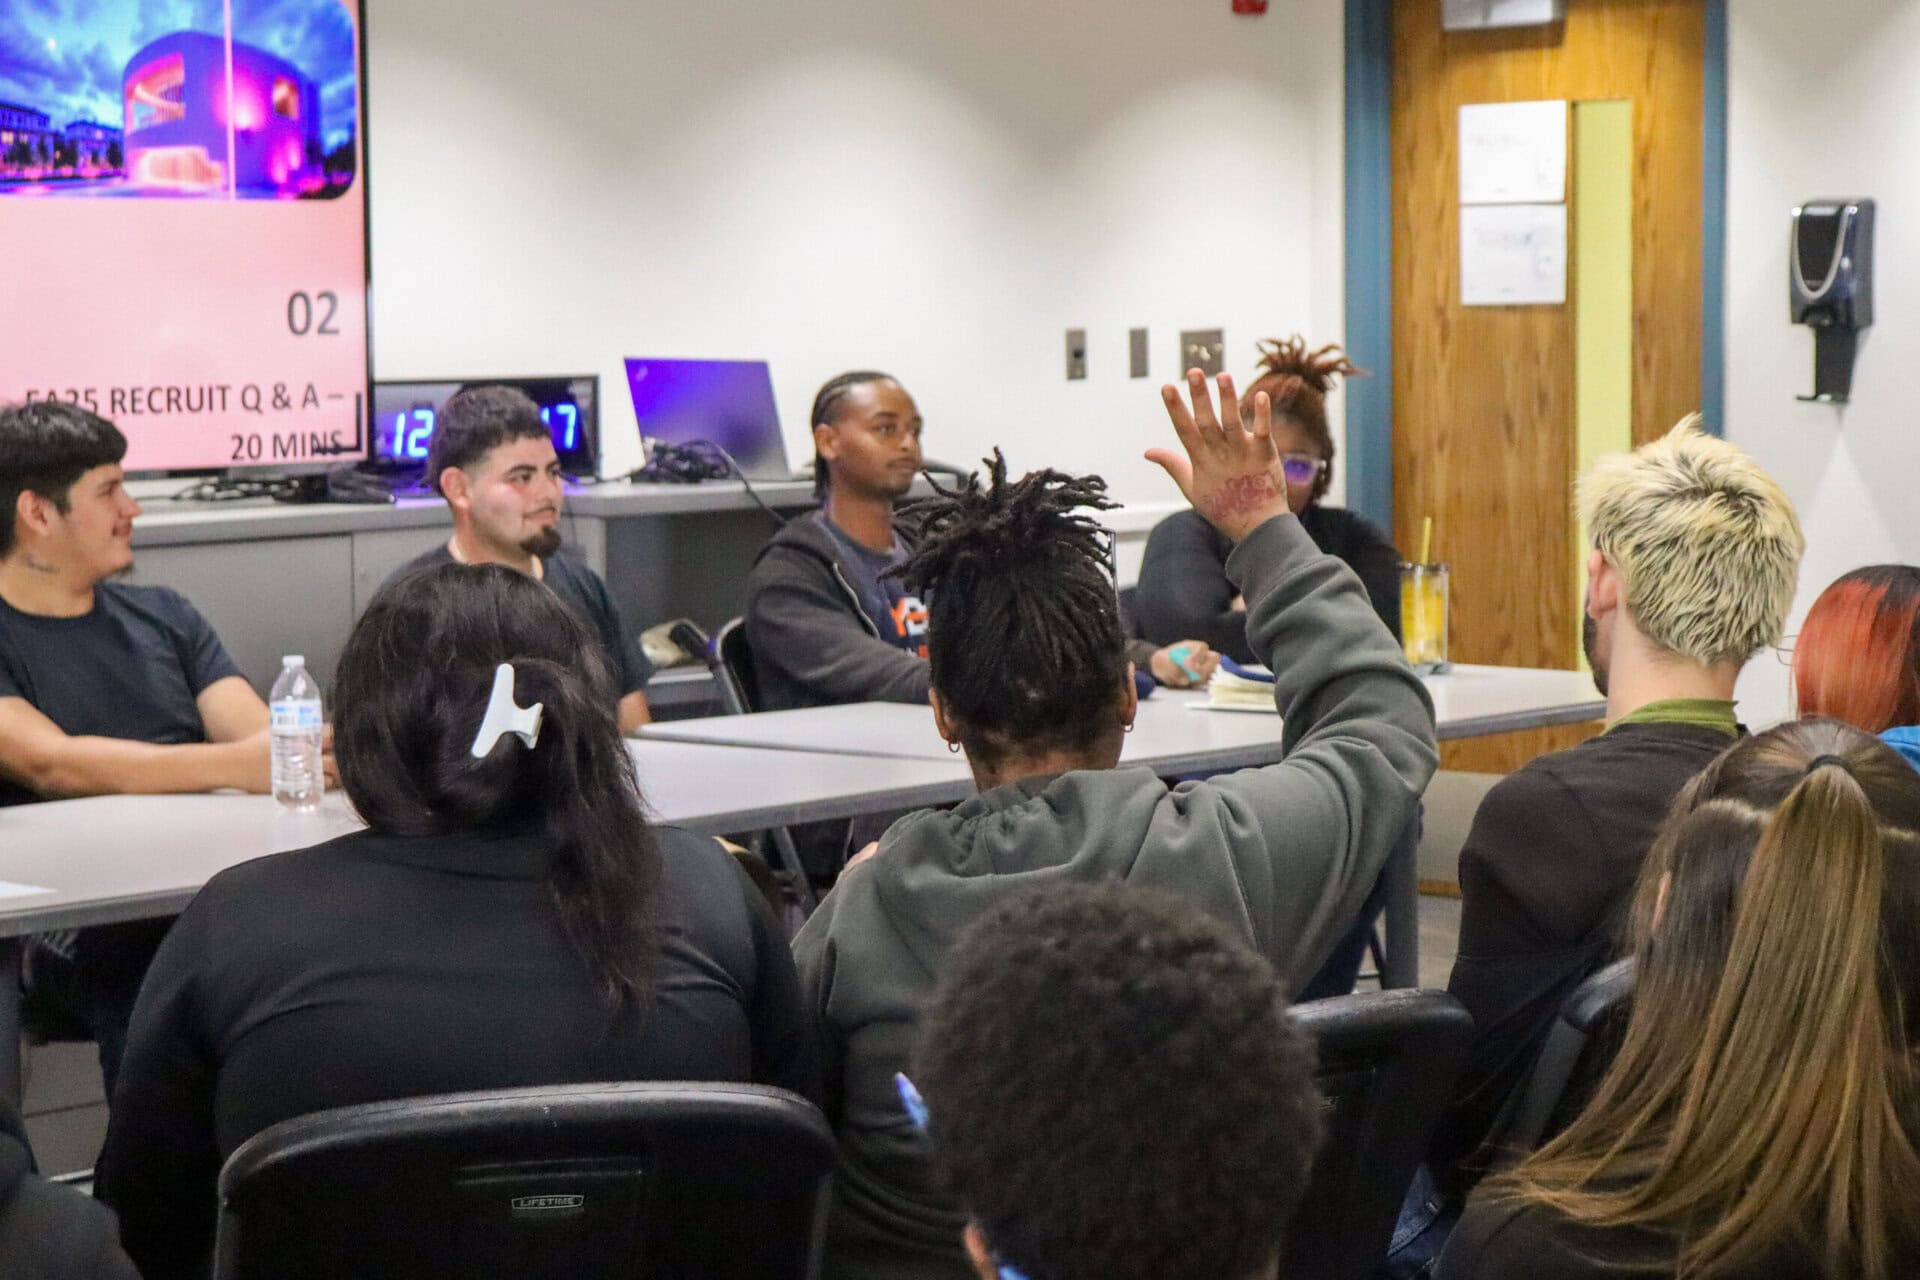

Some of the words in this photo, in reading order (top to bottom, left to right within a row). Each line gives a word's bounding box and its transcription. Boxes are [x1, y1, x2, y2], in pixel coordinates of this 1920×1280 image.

[287, 290, 341, 337] 02
[110, 384, 231, 415] RECRUIT
[241, 384, 263, 415] Q
[271, 382, 292, 411] &
[301, 382, 320, 409] A
[230, 434, 262, 460] 20
[272, 431, 343, 459] MINS
[393, 408, 435, 458] 12
[540, 403, 577, 449] 7
[518, 1197, 577, 1208] LIFETIME
